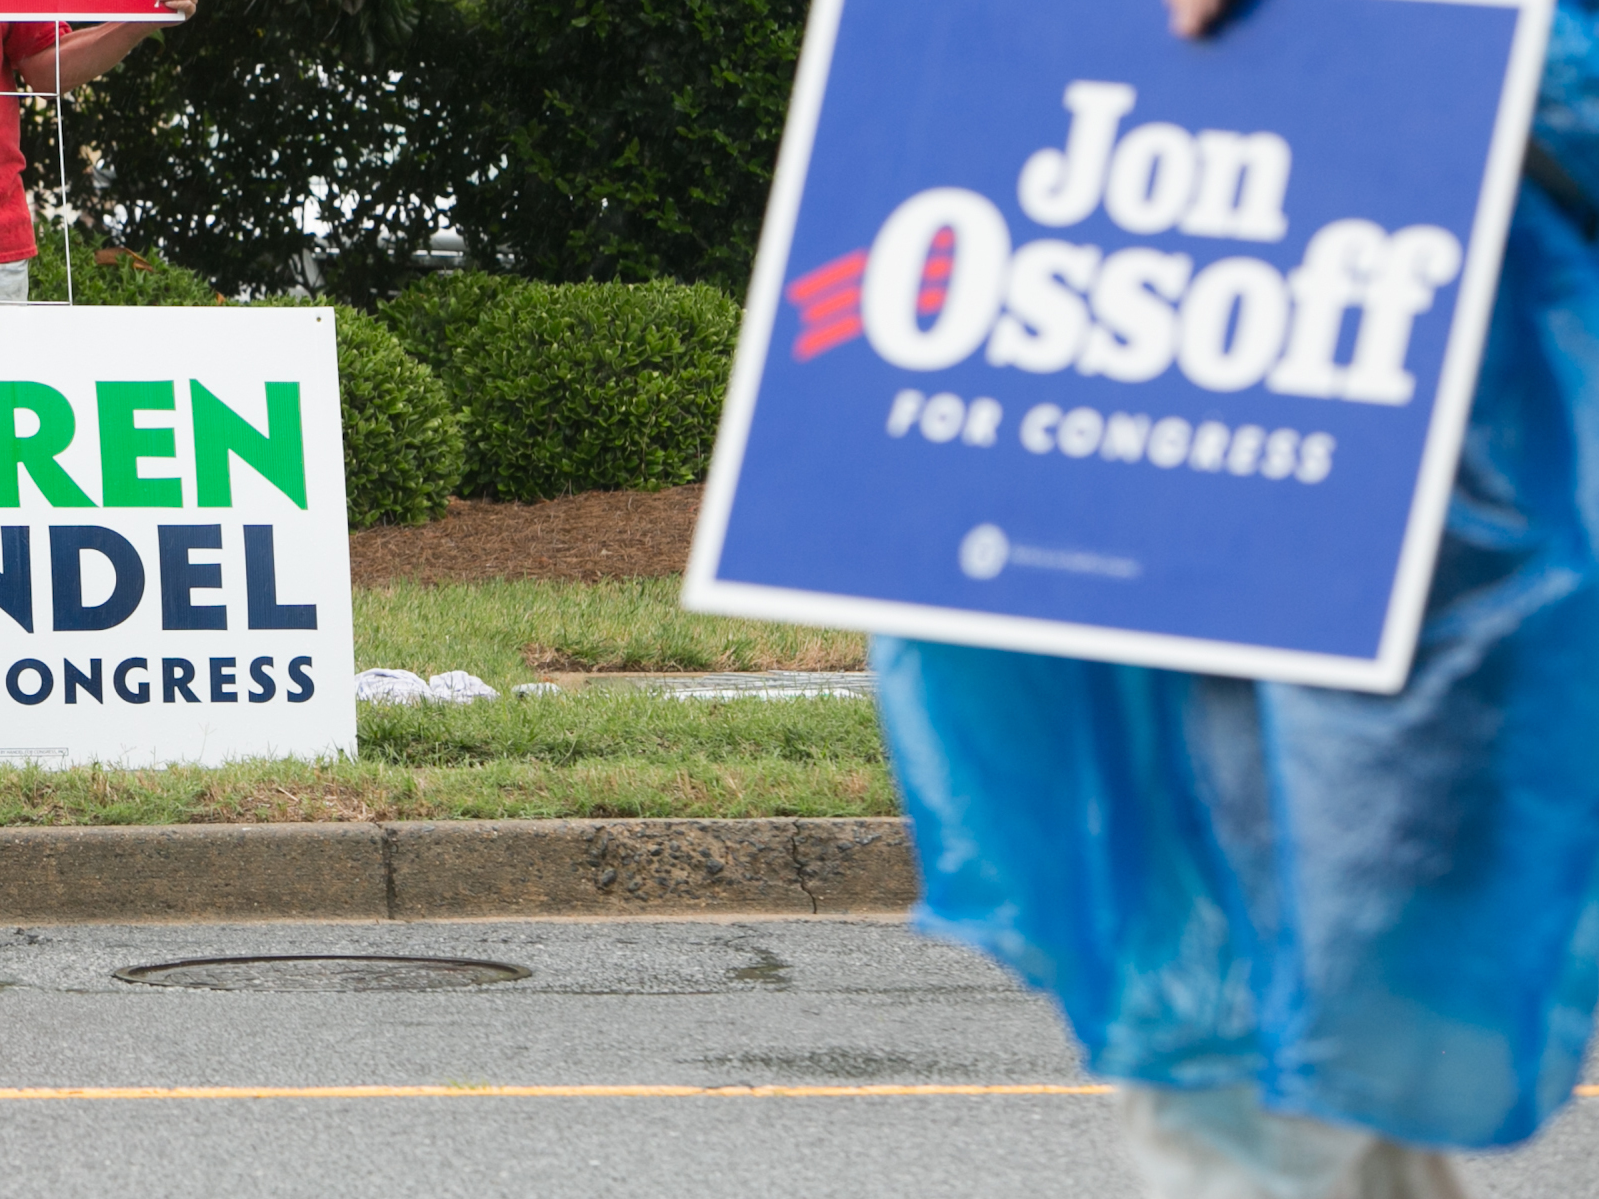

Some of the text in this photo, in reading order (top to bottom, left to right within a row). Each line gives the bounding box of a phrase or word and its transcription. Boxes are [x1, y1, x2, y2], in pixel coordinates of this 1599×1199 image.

[1018, 80, 1293, 243] Jon
[860, 186, 1463, 406] Ossoff
[886, 389, 1336, 484] FOR CONGRESS
